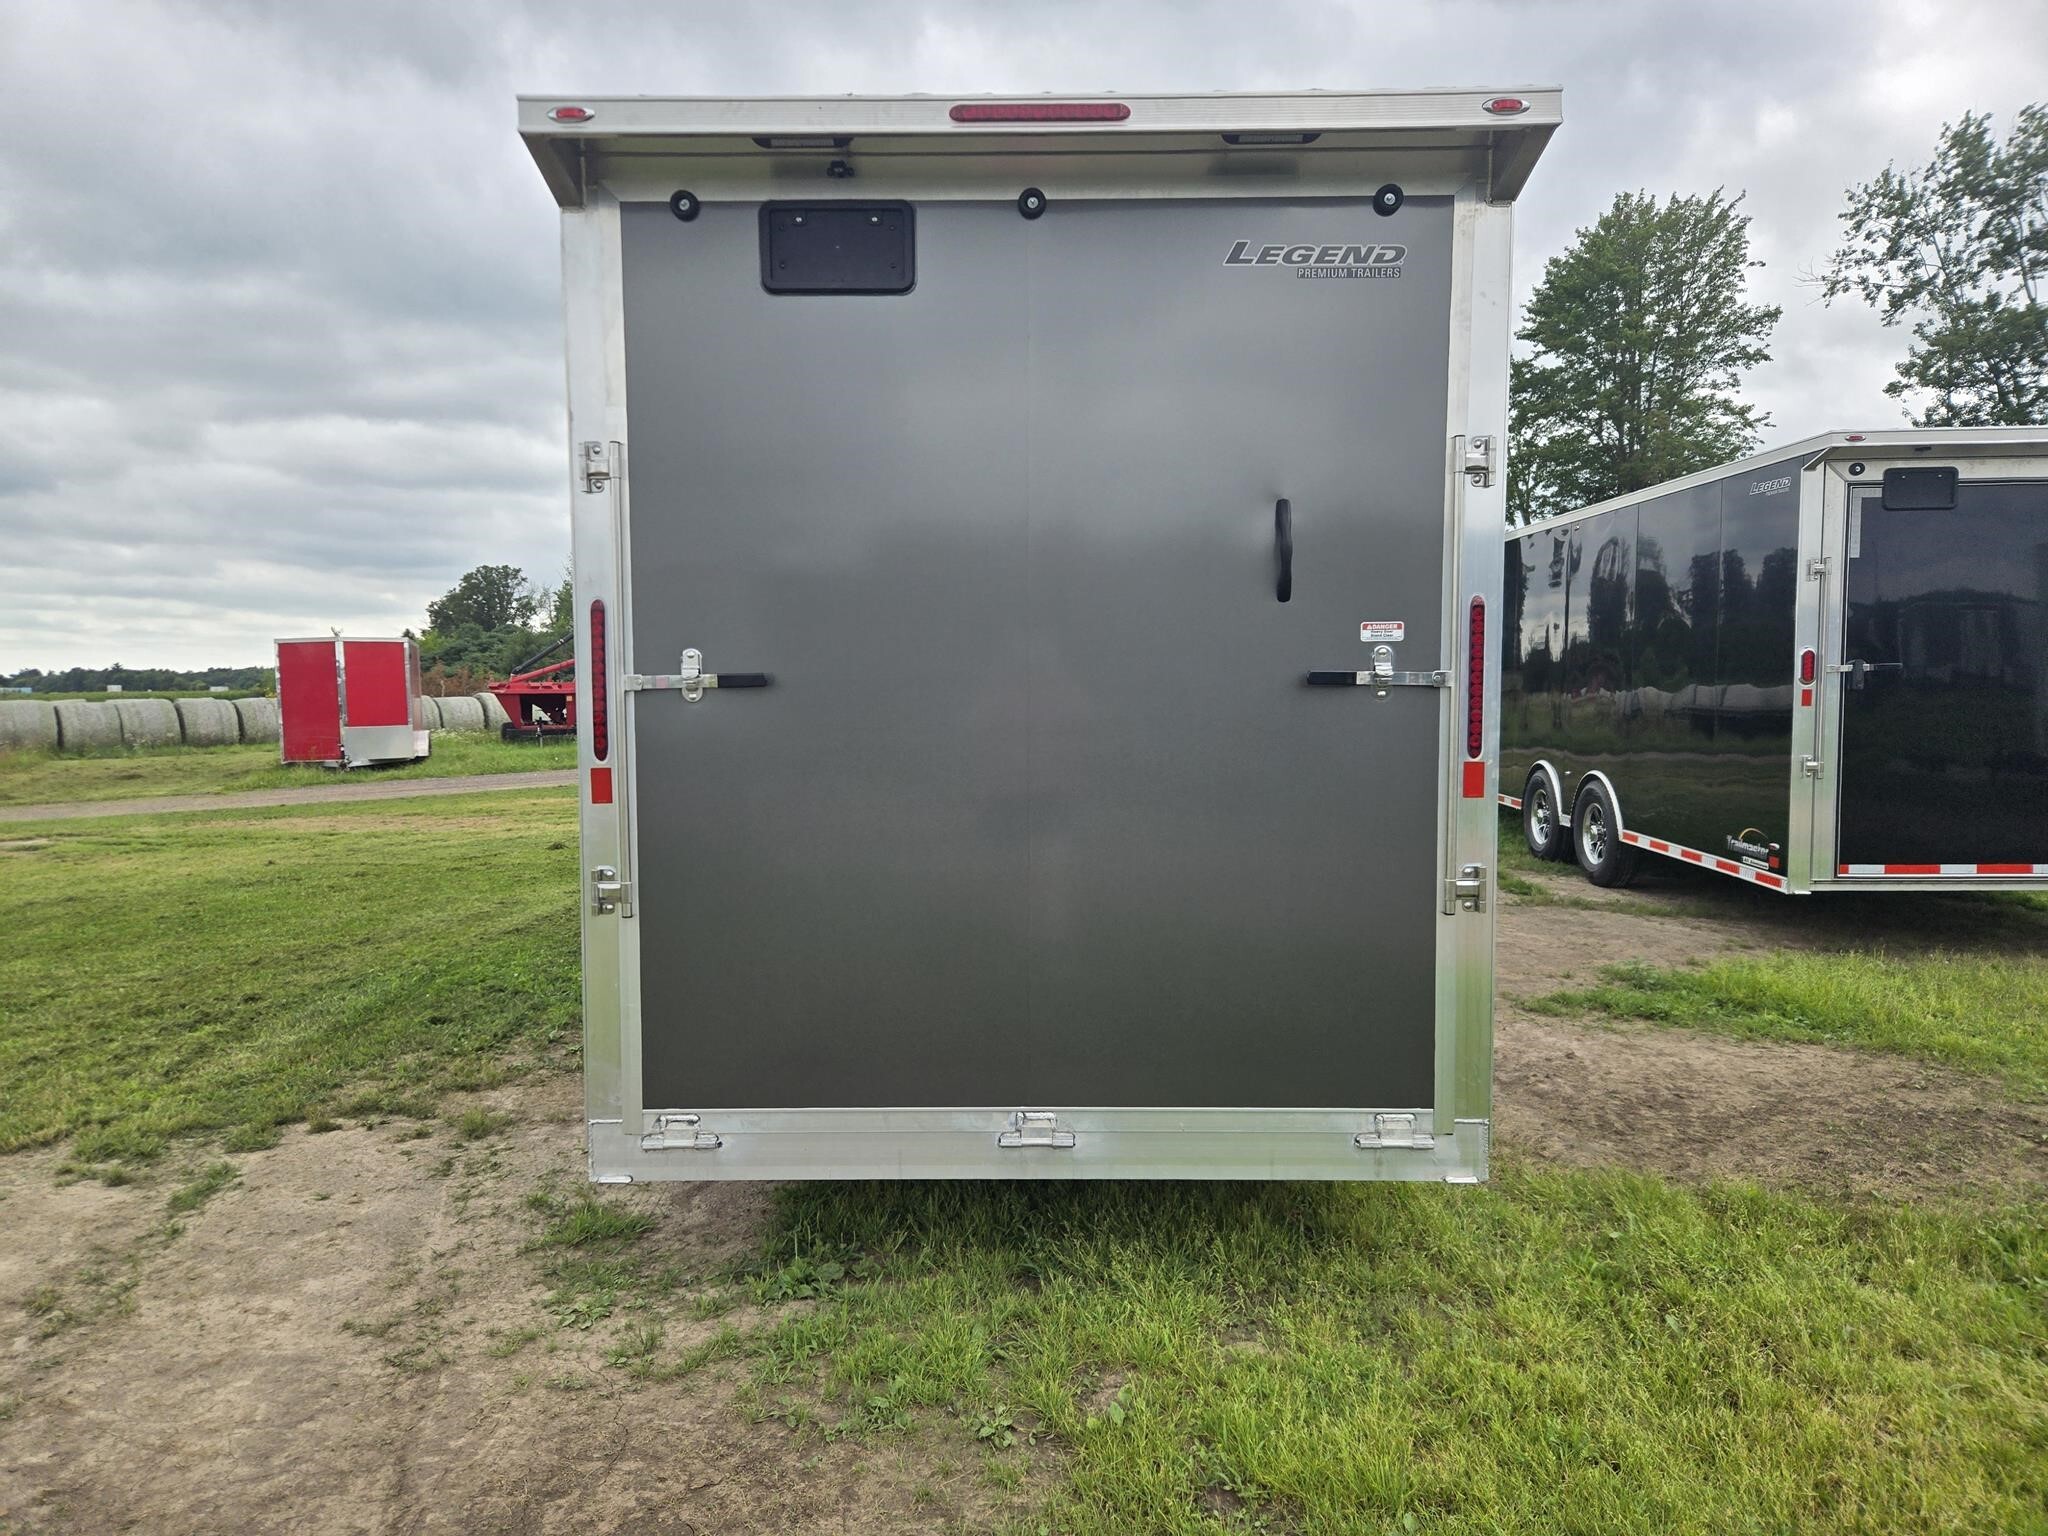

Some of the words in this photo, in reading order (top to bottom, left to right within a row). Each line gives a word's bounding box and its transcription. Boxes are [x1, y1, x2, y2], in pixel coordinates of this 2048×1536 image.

[1223, 240, 1408, 267] LEGEND
[1298, 268, 1348, 279] PREMIUM
[1351, 267, 1401, 278] TRAILERS
[1749, 476, 1792, 495] LEGEND
